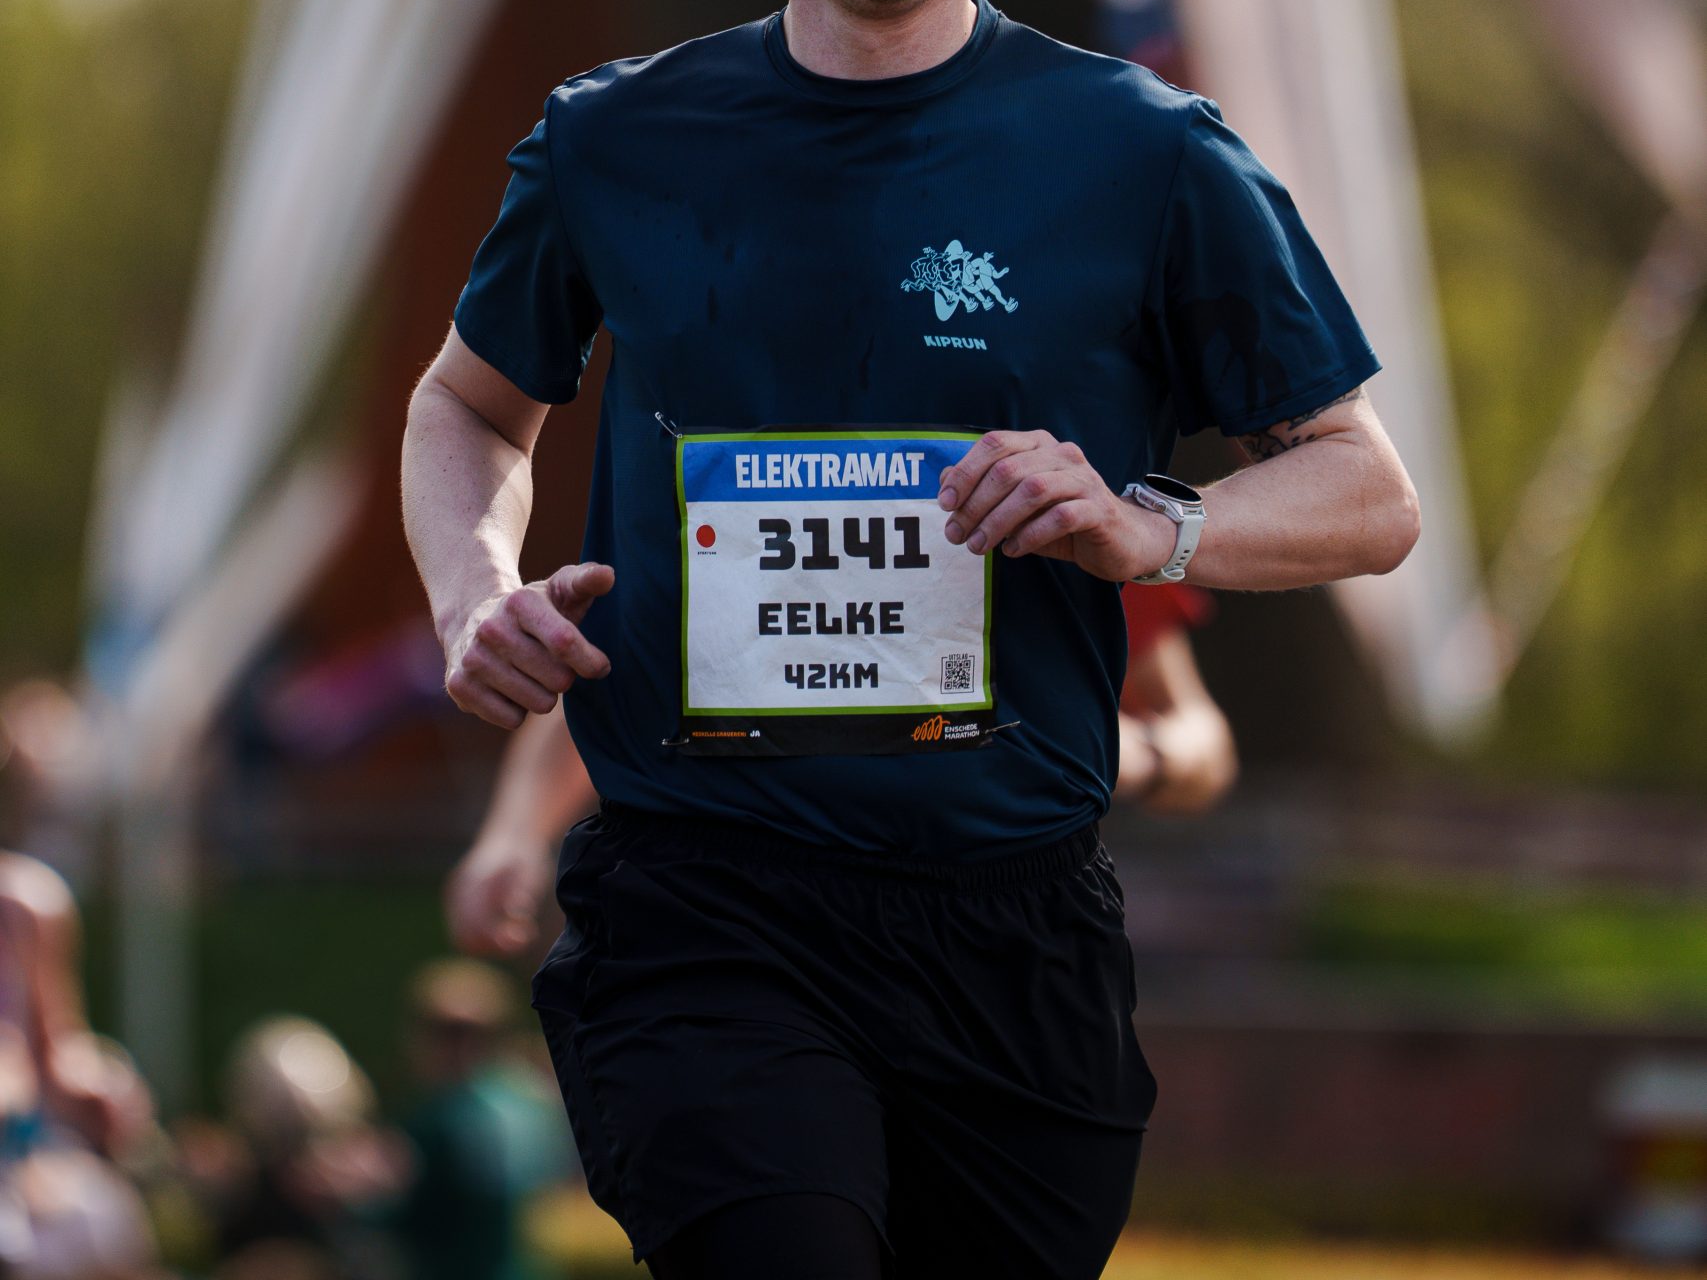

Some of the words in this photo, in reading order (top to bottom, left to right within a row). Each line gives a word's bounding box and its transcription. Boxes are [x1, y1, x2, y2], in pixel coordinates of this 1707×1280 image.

[923, 335, 987, 350] KIPRUN
[735, 452, 924, 488] ELEKTRAMAT
[758, 516, 930, 570] 3141
[758, 602, 905, 635] EELKE
[785, 663, 879, 689] 42KM
[749, 730, 761, 738] JA
[944, 723, 978, 733] ENSCHEDE
[944, 730, 980, 740] MARATHON
